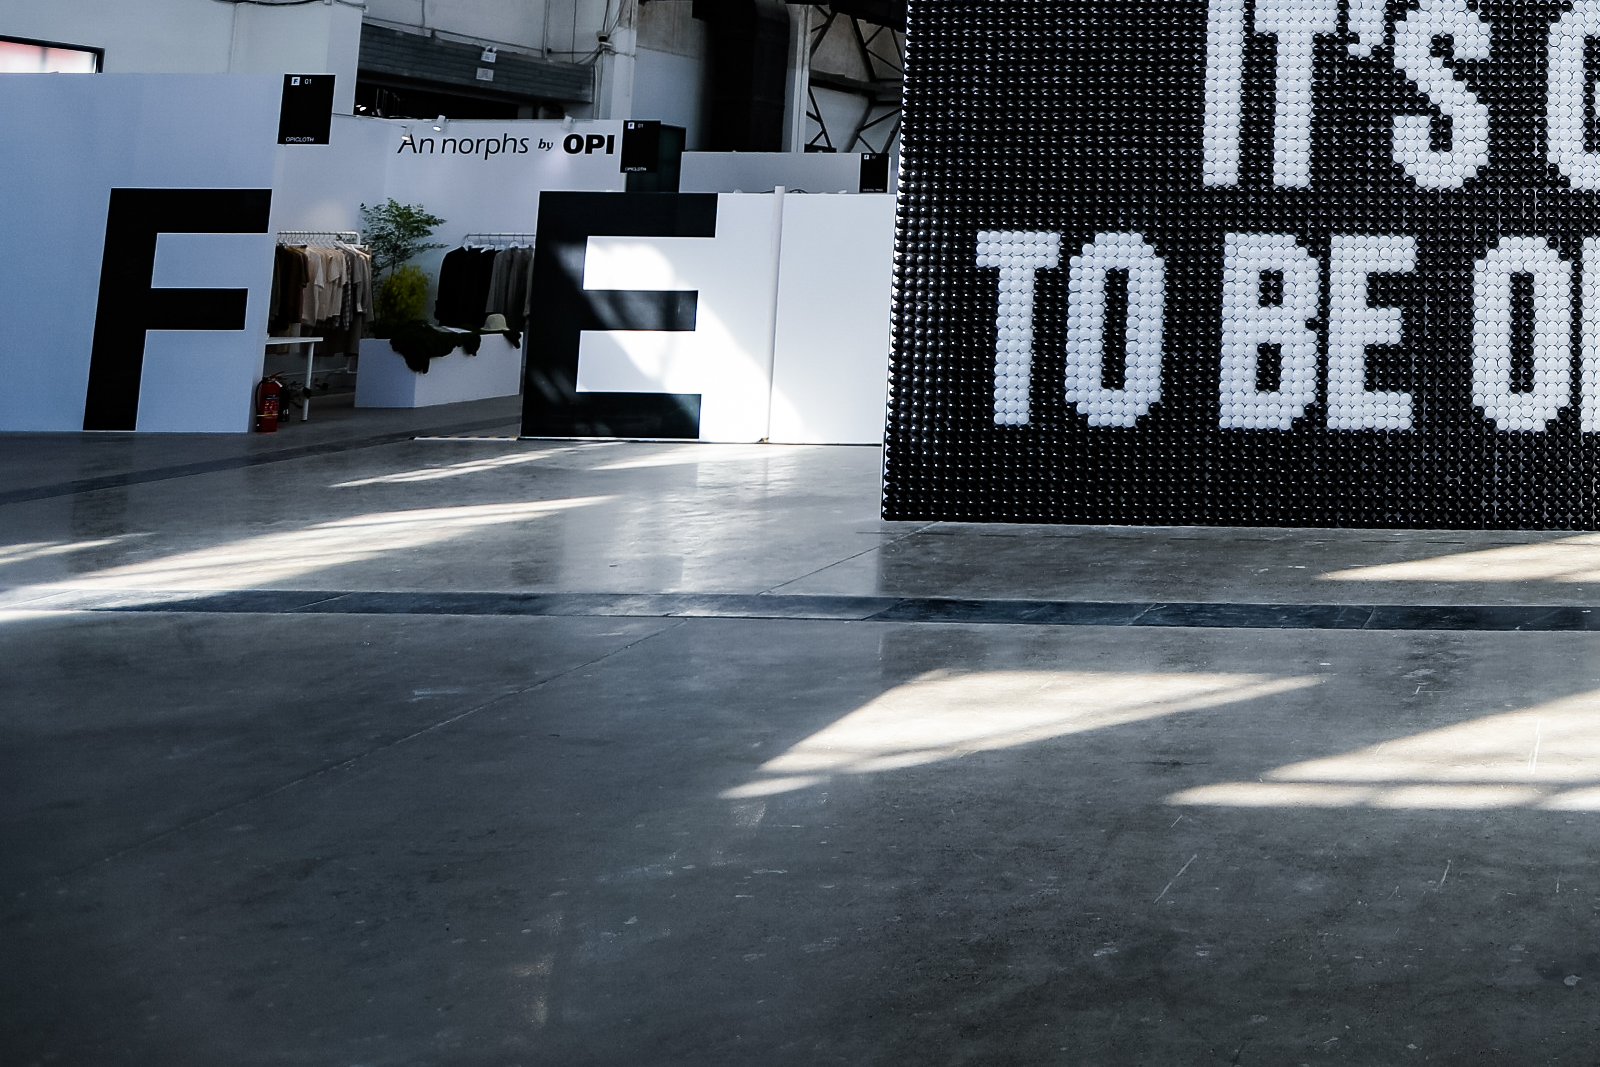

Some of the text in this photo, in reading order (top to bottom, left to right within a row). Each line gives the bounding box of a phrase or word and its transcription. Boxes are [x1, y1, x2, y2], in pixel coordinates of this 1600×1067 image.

[538, 139, 554, 151] by
[563, 133, 615, 155] OPI
[83, 187, 273, 431] F
[520, 190, 719, 439] E
[976, 230, 1167, 428] TO
[1218, 233, 1417, 431] BE
